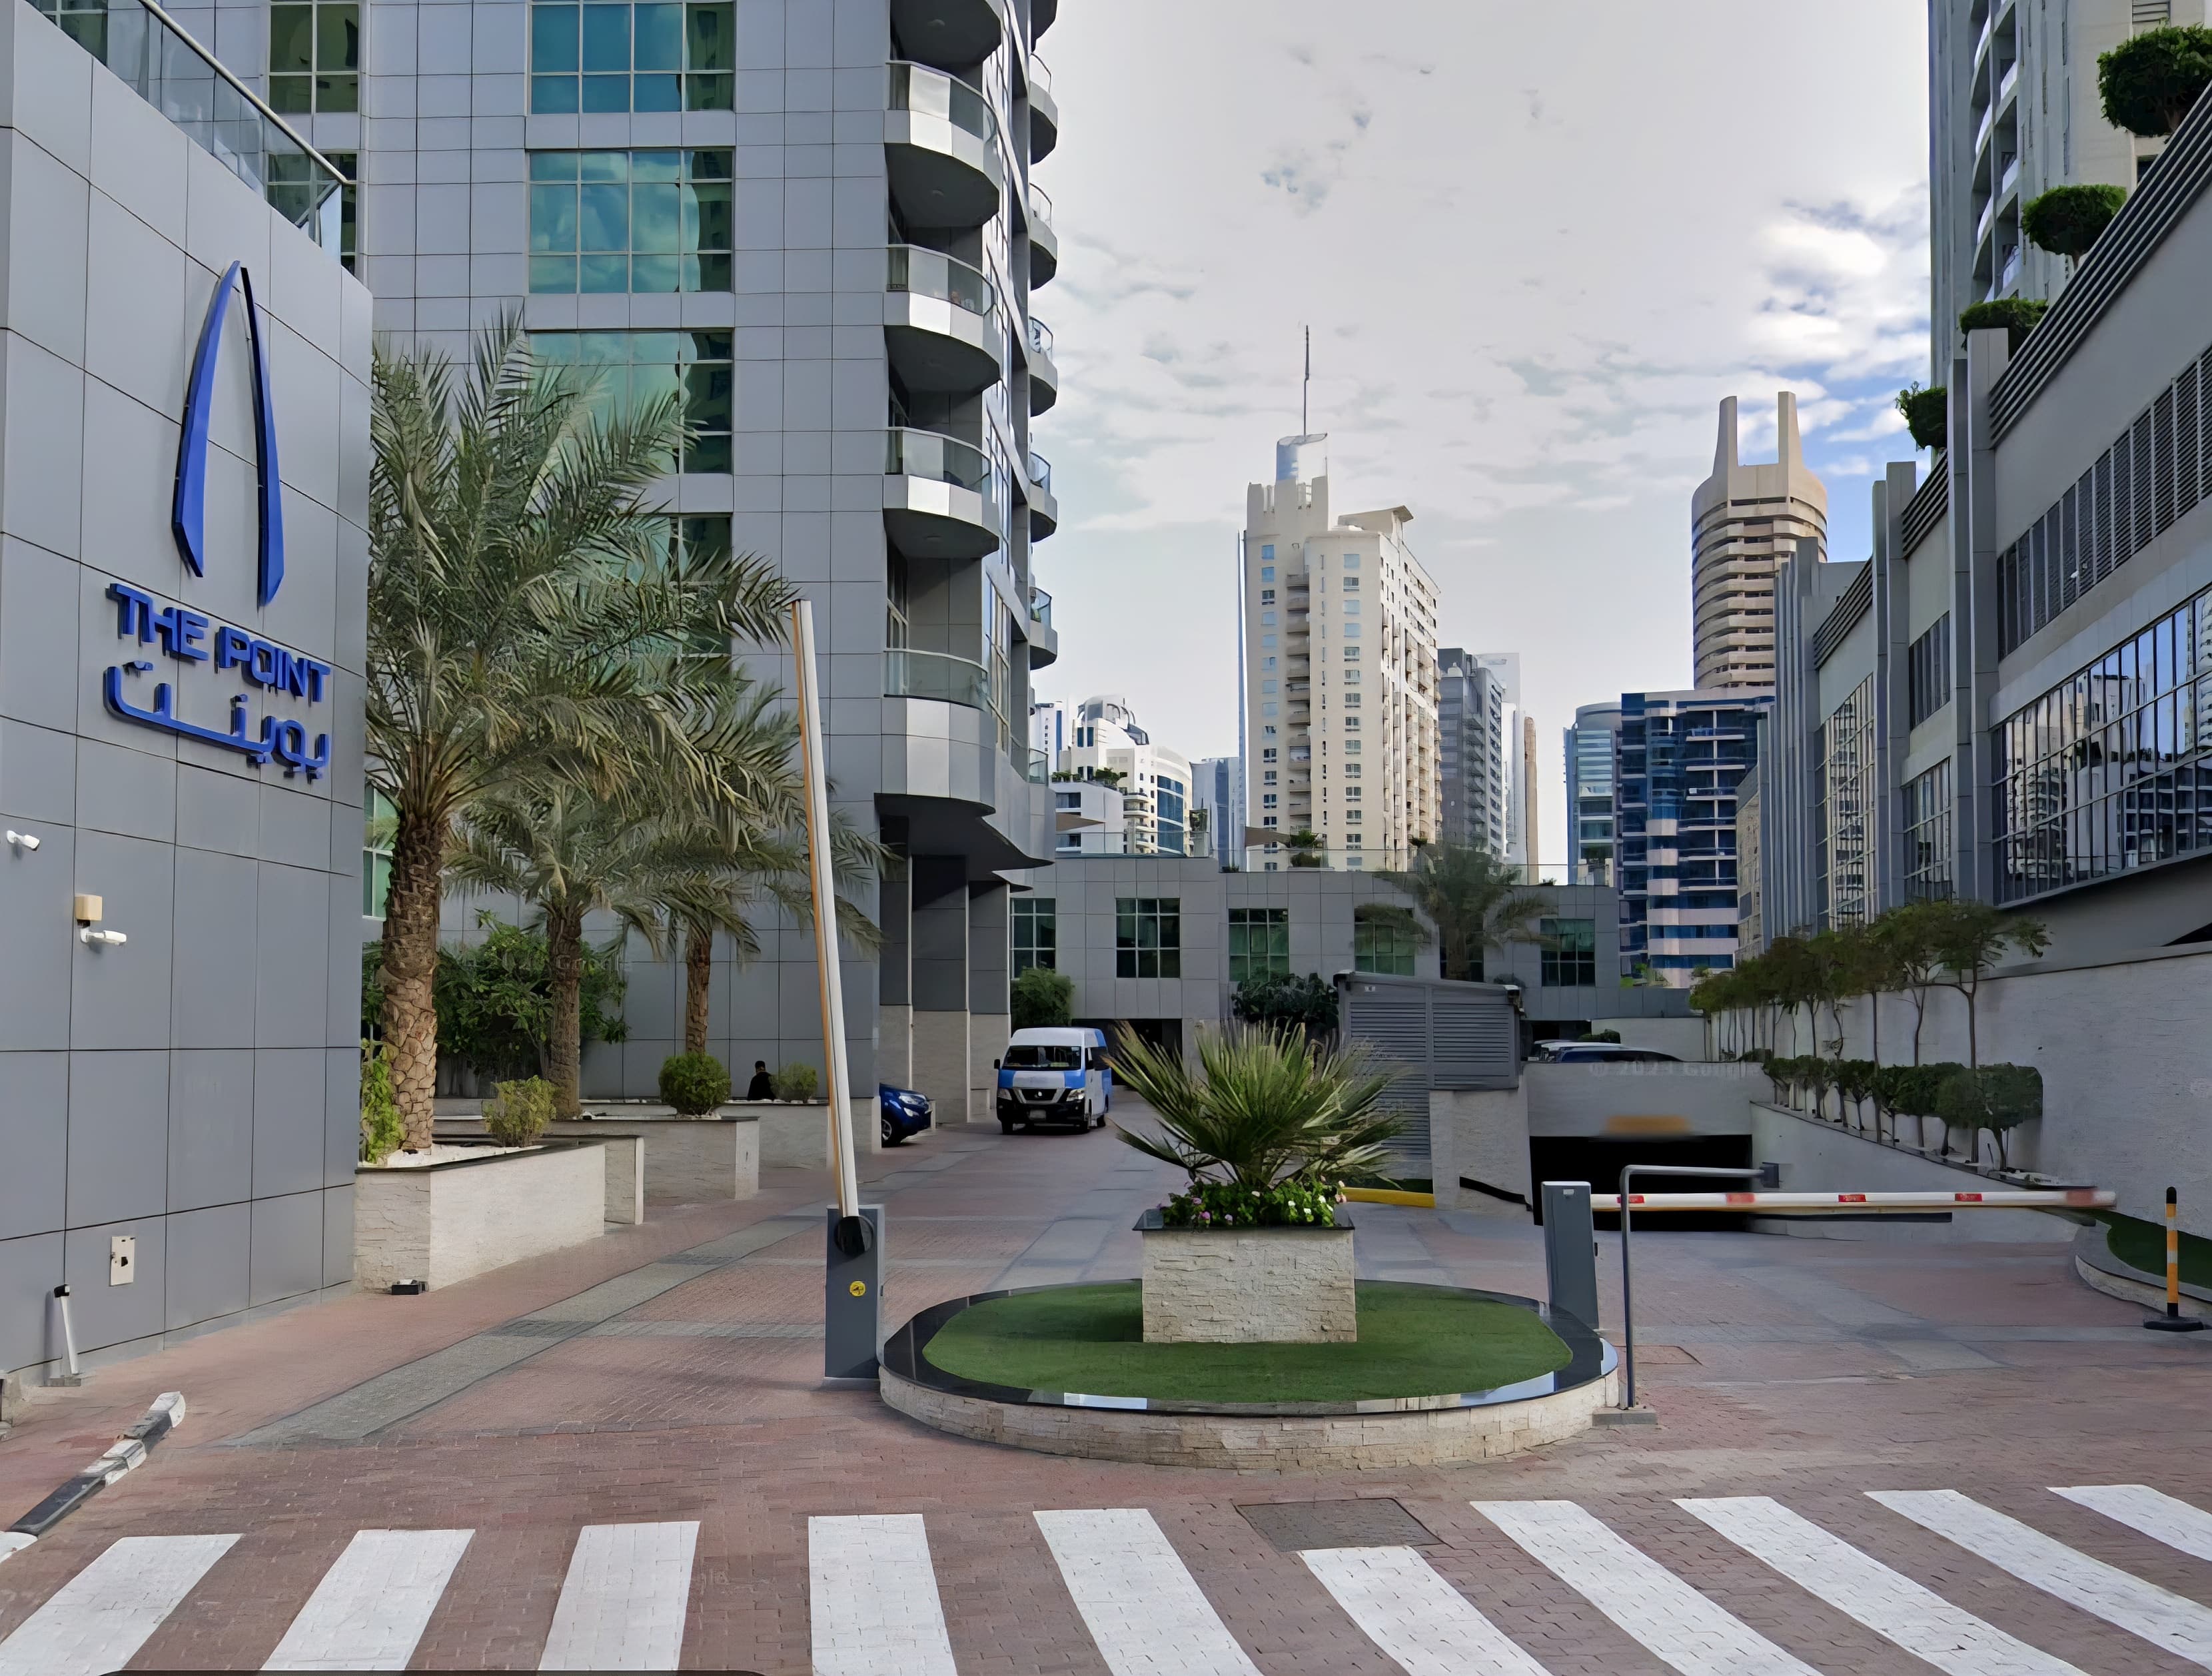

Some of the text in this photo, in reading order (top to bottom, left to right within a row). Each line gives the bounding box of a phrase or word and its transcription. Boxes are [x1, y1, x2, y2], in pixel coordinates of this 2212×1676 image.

[107, 582, 331, 703] THE POINT
[105, 660, 330, 781] بوينت
